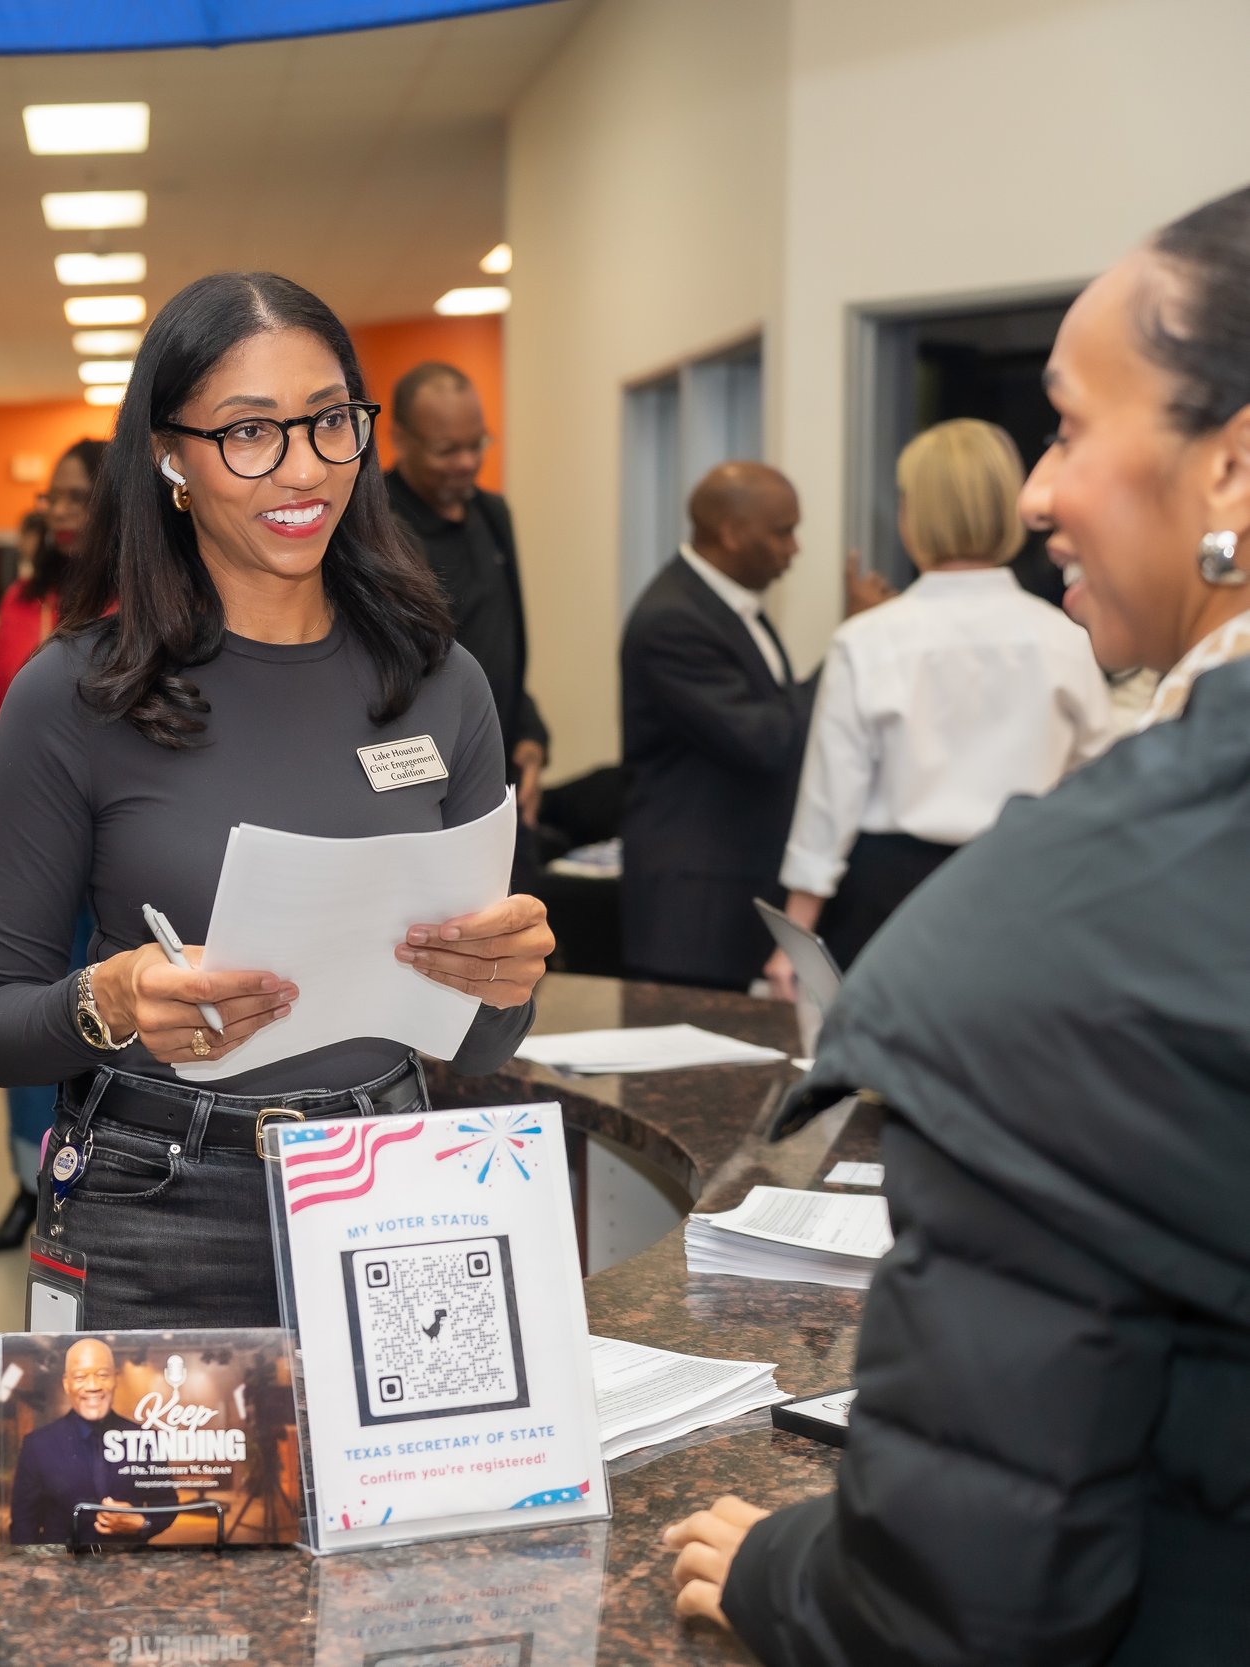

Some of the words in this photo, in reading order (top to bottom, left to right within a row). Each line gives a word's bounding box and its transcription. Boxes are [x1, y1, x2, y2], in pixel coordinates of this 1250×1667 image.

[369, 762, 390, 774] Civic
[390, 753, 437, 770] Engagement
[371, 751, 391, 762] Lake
[391, 745, 424, 758] Houston
[390, 768, 426, 781] Coalition
[347, 1224, 368, 1239] MY
[375, 1216, 425, 1233] VOTER
[431, 1214, 489, 1226] STATUS
[134, 1391, 219, 1433] Keep
[103, 1429, 246, 1462] STANDING
[344, 1444, 393, 1460] TEXAS
[397, 1434, 480, 1455] SECRETARY
[486, 1431, 505, 1444] OF
[510, 1425, 555, 1441] STATE
[360, 1470, 417, 1486] Confirm
[422, 1463, 464, 1480] you're
[470, 1452, 546, 1473] registered!
